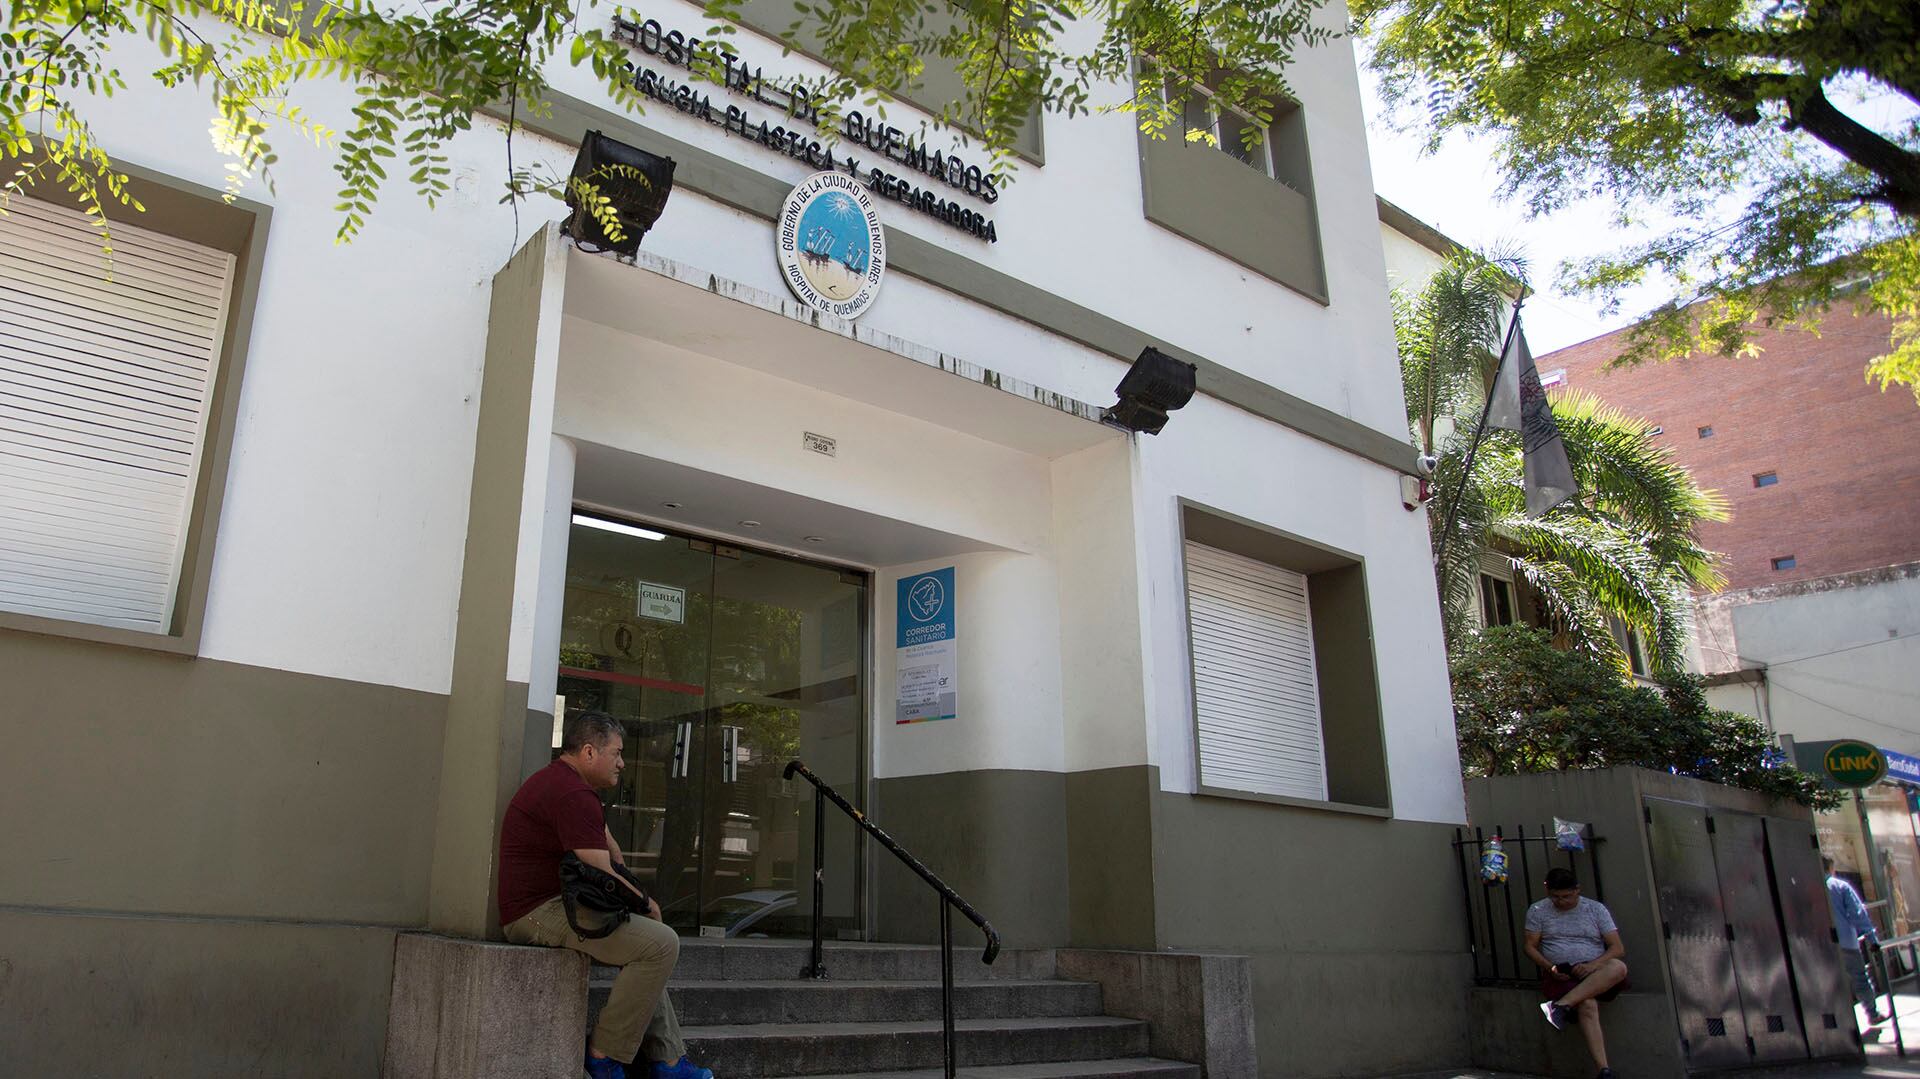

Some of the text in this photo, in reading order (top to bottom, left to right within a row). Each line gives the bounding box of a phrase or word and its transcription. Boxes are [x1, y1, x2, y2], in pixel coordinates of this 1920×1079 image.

[726, 104, 835, 171] PLASTICA
[846, 156, 861, 179] Y
[869, 168, 998, 244] REPARADORA
[847, 110, 999, 204] QUEMADOS
[782, 175, 882, 285] GOBIERNO DE LA CIUDAD DE BUENOS AIRES
[788, 264, 870, 317] HOSPITAL DE QUEMADOS
[642, 590, 681, 603] GUARDIA
[906, 623, 945, 637] CORREDOR
[906, 632, 945, 645] SANITARIO
